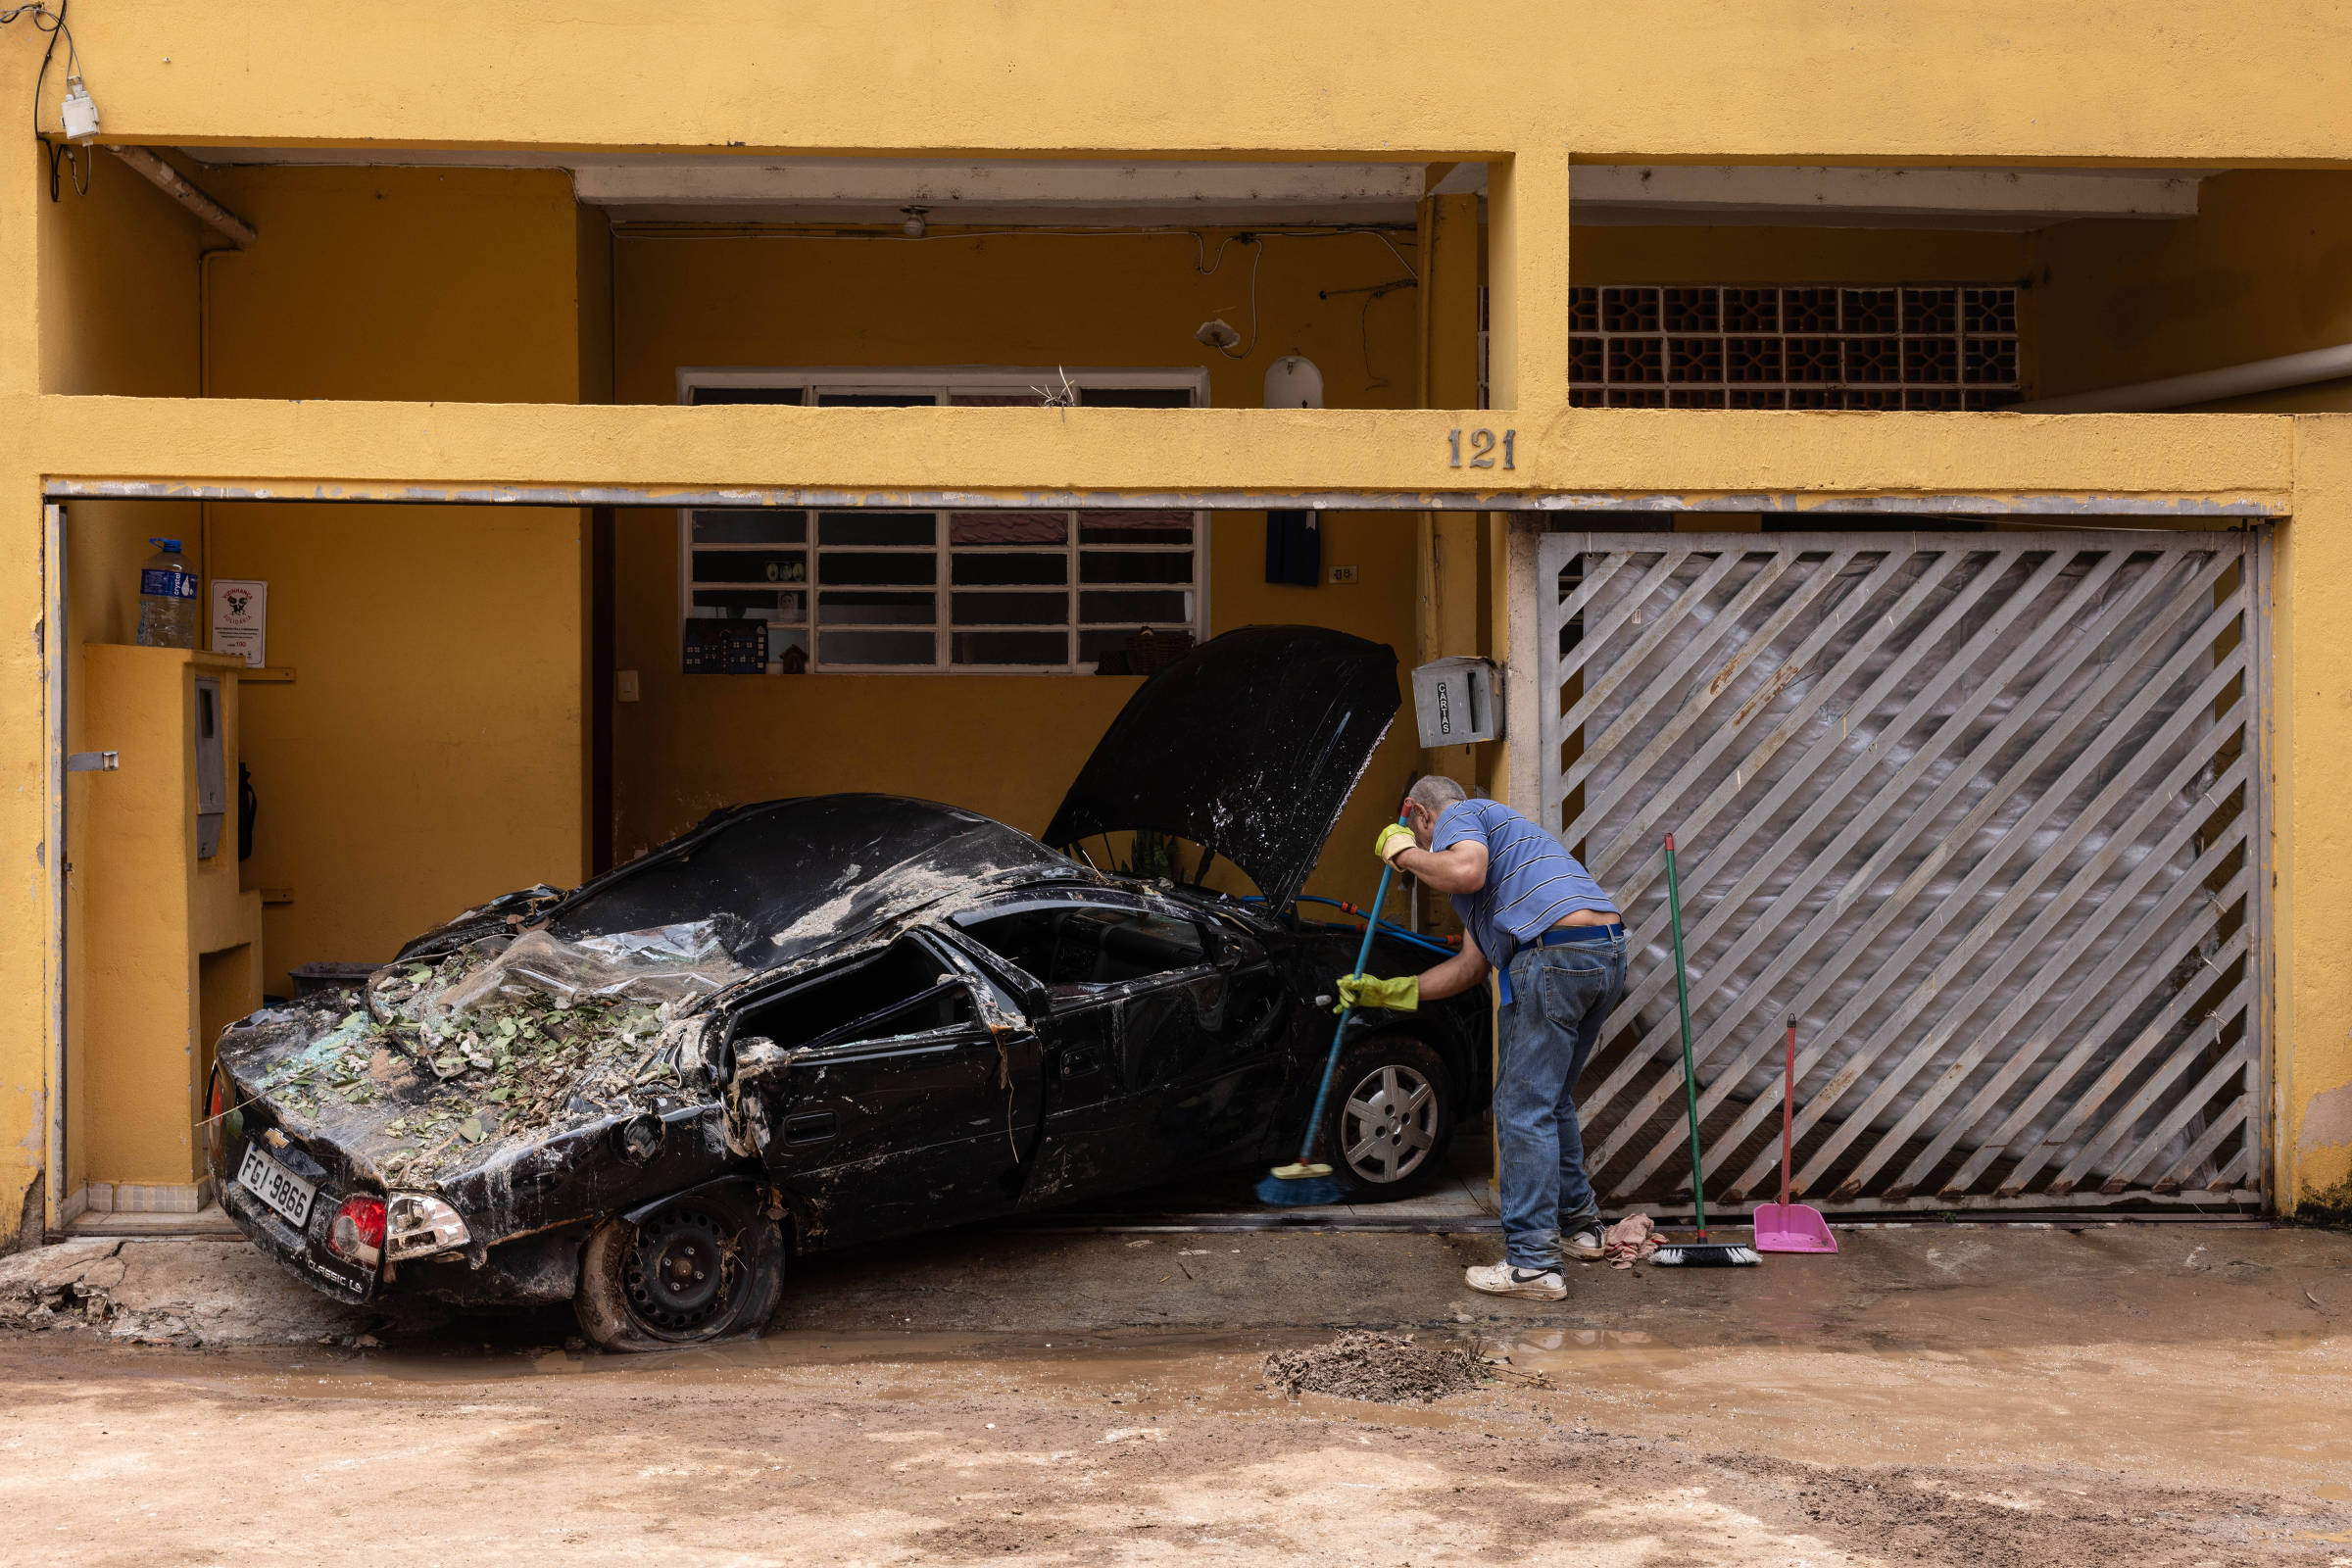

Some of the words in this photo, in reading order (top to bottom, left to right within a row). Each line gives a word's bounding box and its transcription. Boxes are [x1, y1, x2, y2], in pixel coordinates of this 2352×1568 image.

[1447, 427, 1516, 469] 121
[1438, 683, 1449, 733] CARTAS
[307, 1259, 347, 1287] CLASSIC
